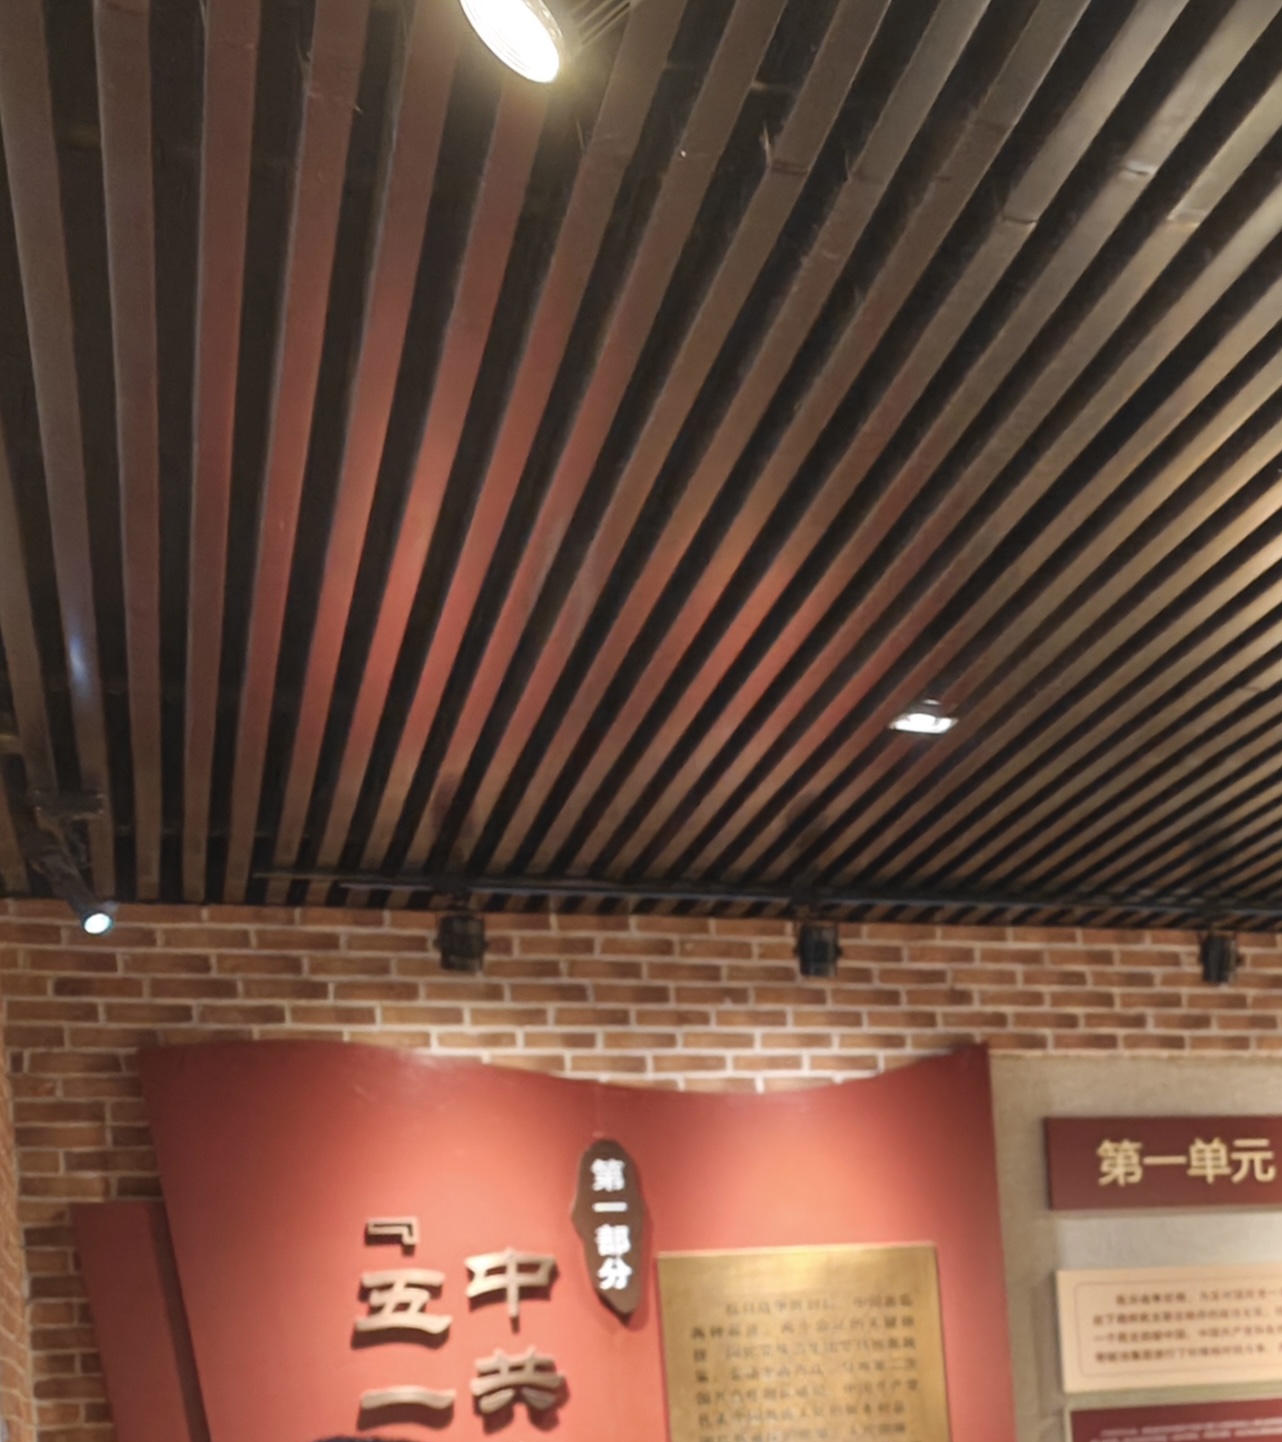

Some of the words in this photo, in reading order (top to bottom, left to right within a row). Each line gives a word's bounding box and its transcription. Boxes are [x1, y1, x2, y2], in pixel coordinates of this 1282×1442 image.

[1096, 1137, 1276, 1186] 第一单元
[590, 1158, 633, 1290] 第一部分
